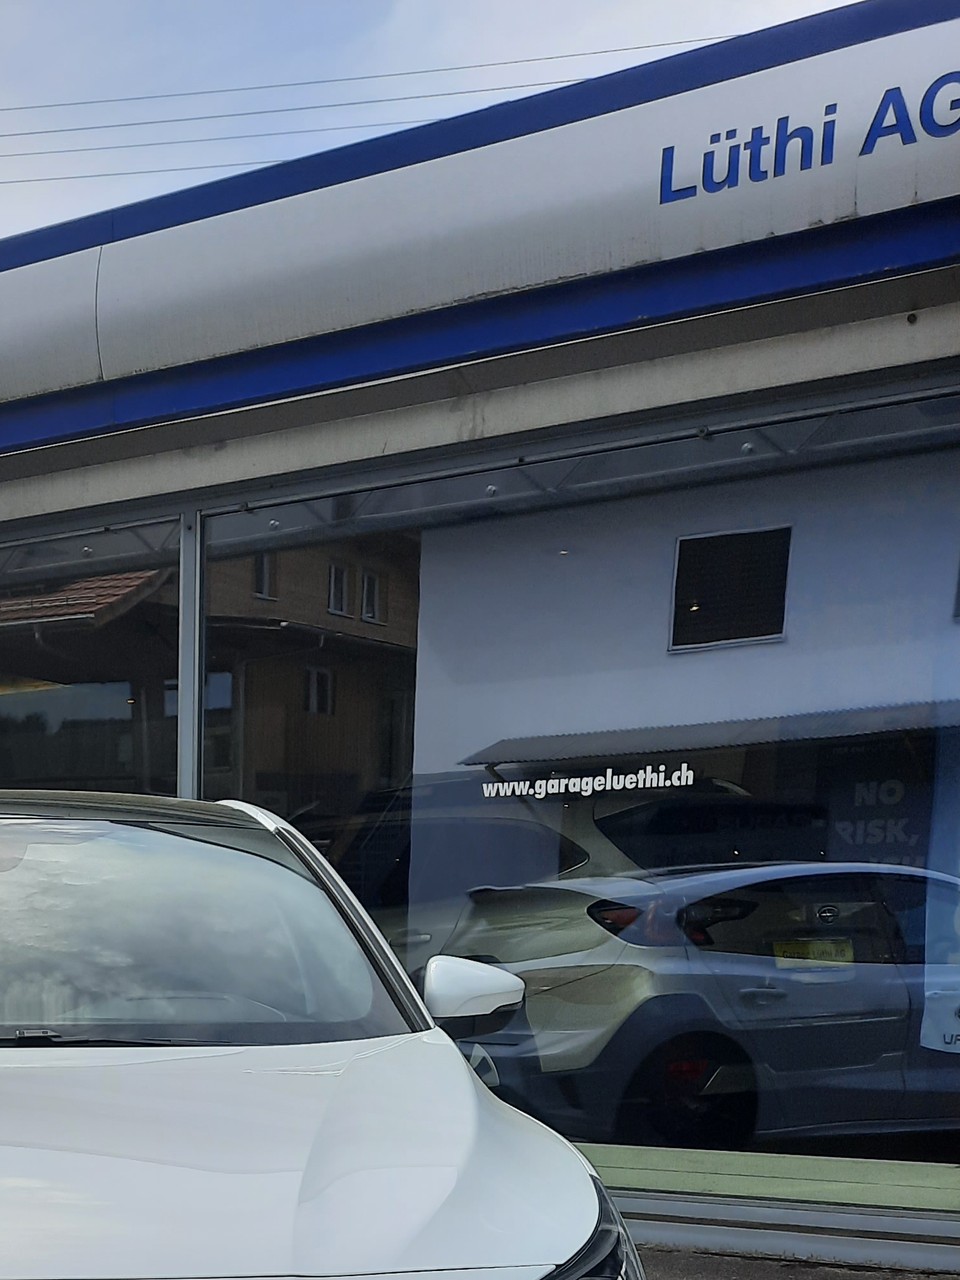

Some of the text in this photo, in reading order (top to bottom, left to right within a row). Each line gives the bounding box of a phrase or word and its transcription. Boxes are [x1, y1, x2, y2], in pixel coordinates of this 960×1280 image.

[660, 71, 960, 205] Lüthi AG
[482, 763, 694, 798] www.garageluethi.ch
[855, 780, 905, 806] NO
